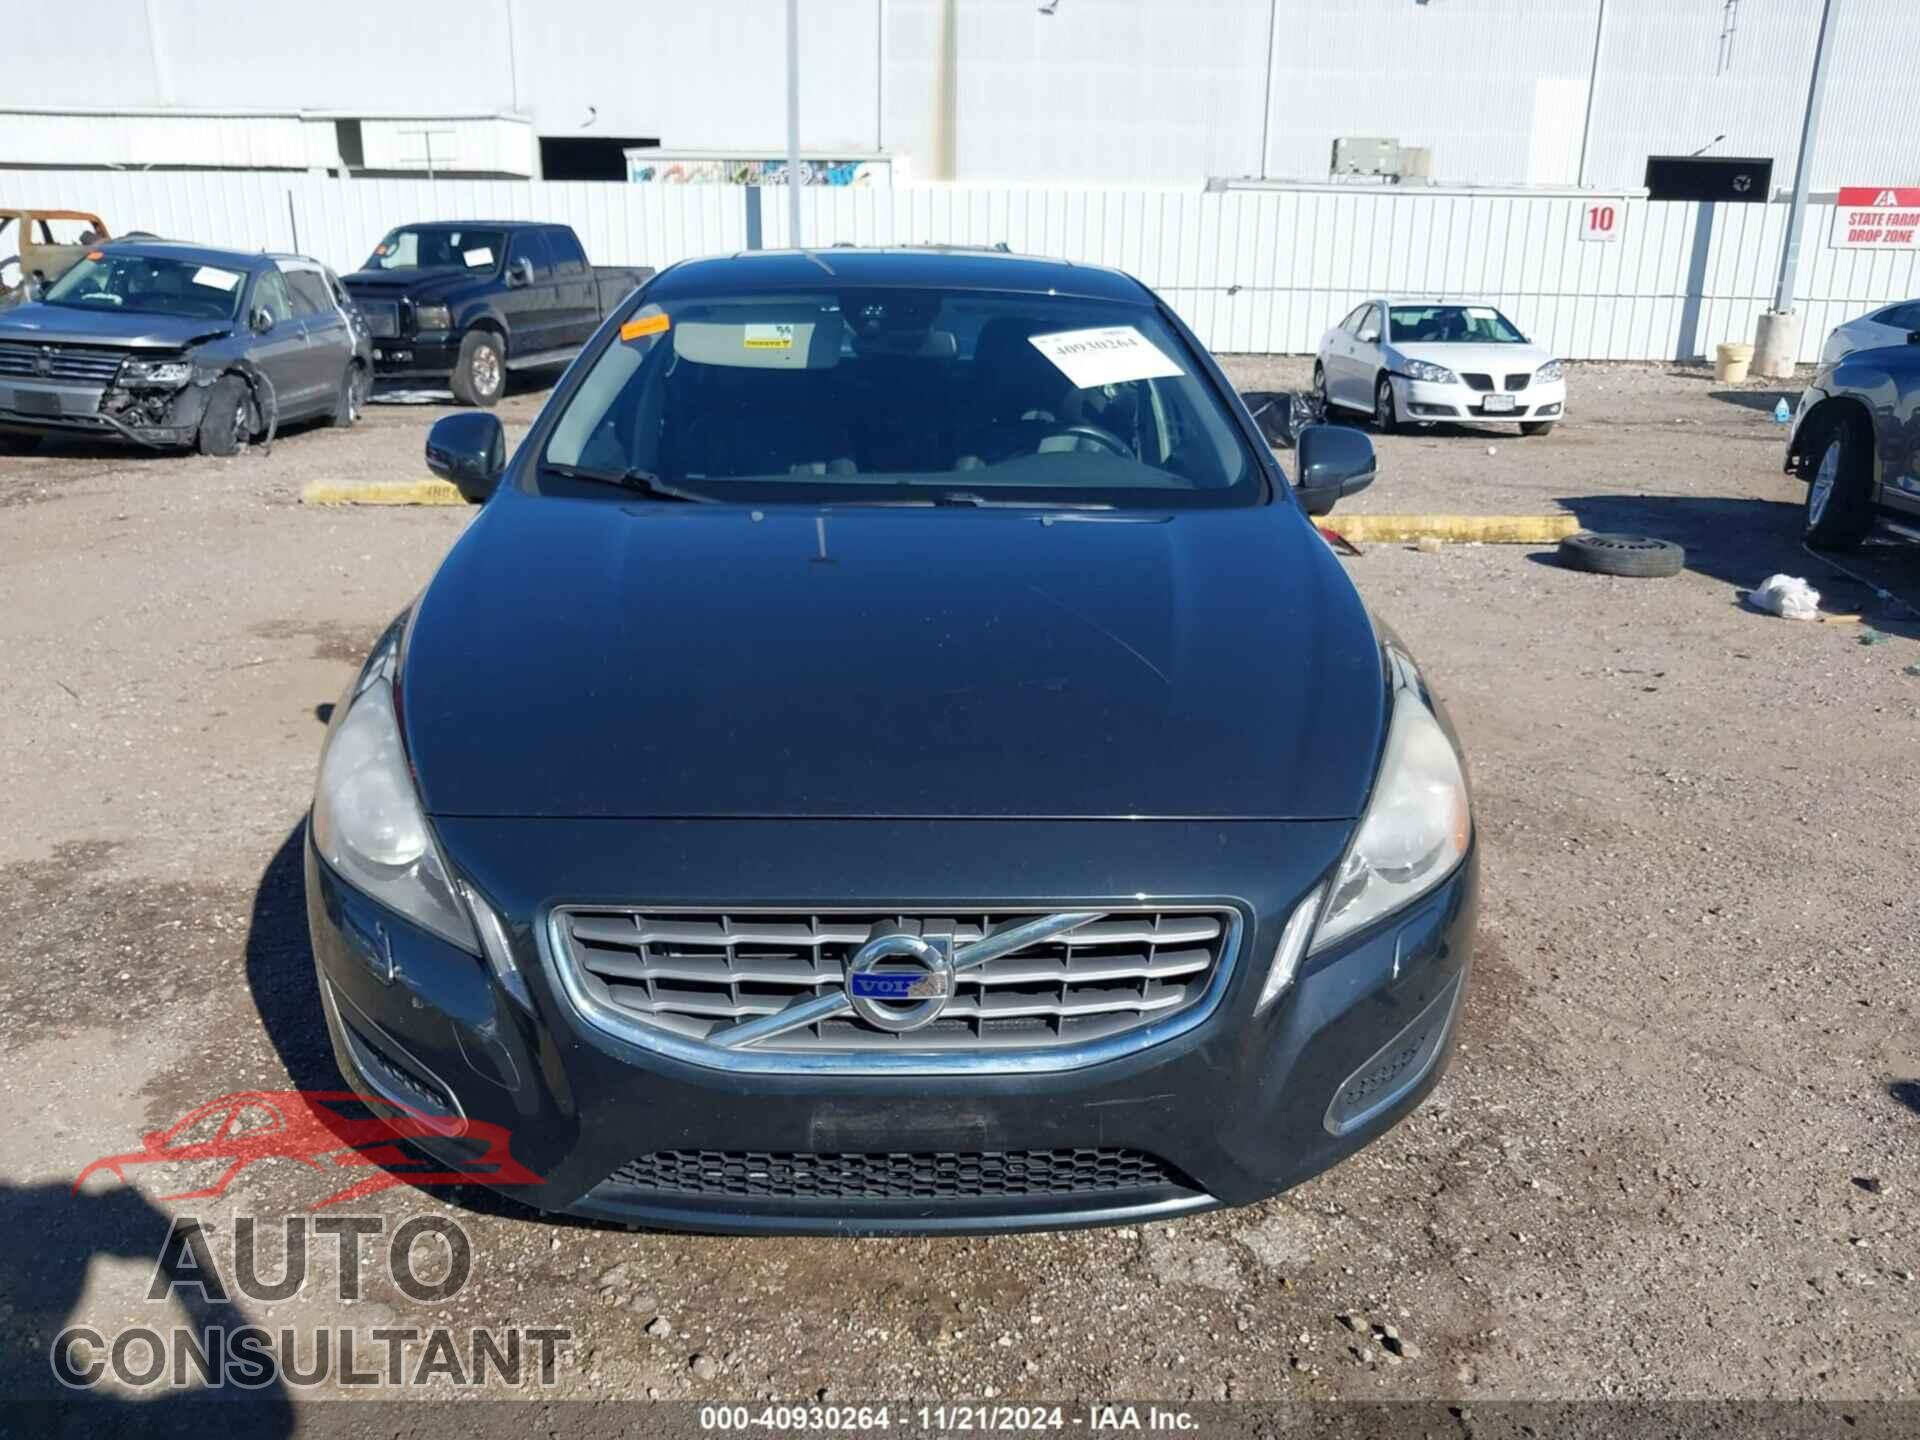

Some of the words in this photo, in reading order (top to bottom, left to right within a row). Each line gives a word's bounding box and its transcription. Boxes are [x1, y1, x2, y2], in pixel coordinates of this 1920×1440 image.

[1589, 206, 1614, 231] 10
[1848, 212, 1885, 226] STATE
[1886, 212, 1920, 227] FARM
[1847, 229, 1882, 242] DROP
[1883, 230, 1915, 243] ZONE
[857, 978, 922, 993] VOL
